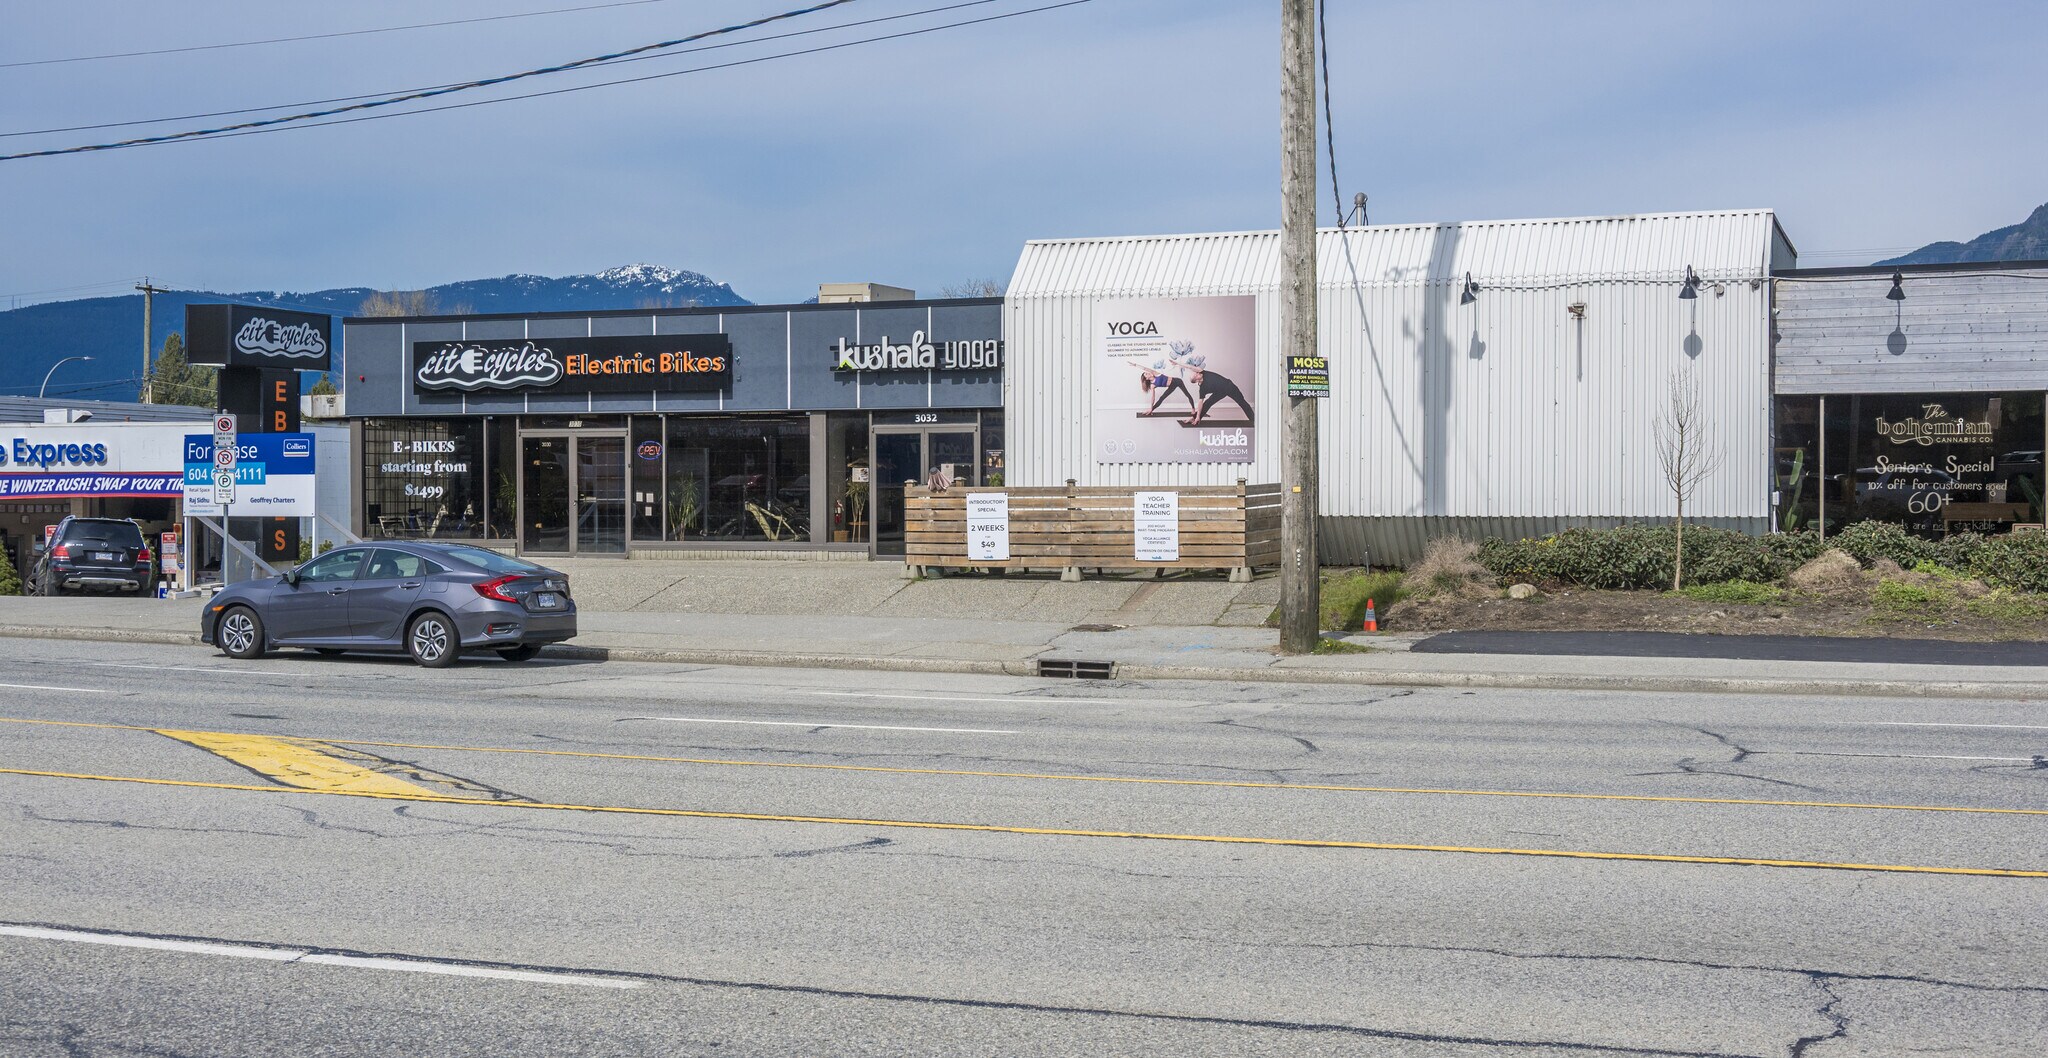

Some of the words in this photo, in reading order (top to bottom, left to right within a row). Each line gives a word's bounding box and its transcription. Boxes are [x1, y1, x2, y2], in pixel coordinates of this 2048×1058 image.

[1107, 321, 1158, 335] YOGA
[836, 330, 935, 370] kushala
[945, 340, 998, 368] yoga
[566, 353, 654, 375] Electric
[659, 352, 725, 373] Bikes
[1293, 357, 1325, 368] MOSS
[914, 414, 938, 423] 3032
[1922, 403, 1948, 419] The
[1199, 428, 1248, 447] kushala
[1876, 417, 1992, 445] bohemian
[13, 438, 105, 468] Express
[188, 443, 211, 459] For
[412, 441, 455, 453] BIKES
[639, 445, 661, 456] OPEN
[188, 468, 208, 480] 604
[235, 468, 262, 480] 4111
[381, 459, 432, 476] starting
[433, 459, 468, 473] from
[1874, 455, 1932, 475] Senior's
[1945, 455, 1995, 481] Special
[10, 479, 57, 494] WINTER
[55, 477, 94, 491] RUSH!
[93, 477, 129, 491] SWAP
[130, 478, 166, 490] YOUR
[405, 483, 444, 498] $1499
[1867, 482, 1883, 490] 10%
[1887, 478, 1906, 490] off
[1912, 478, 1928, 490] for
[1932, 478, 1982, 490] customers
[1985, 479, 2008, 497] aged
[1908, 491, 1954, 514] 60+
[977, 524, 1005, 532] WEEKS
